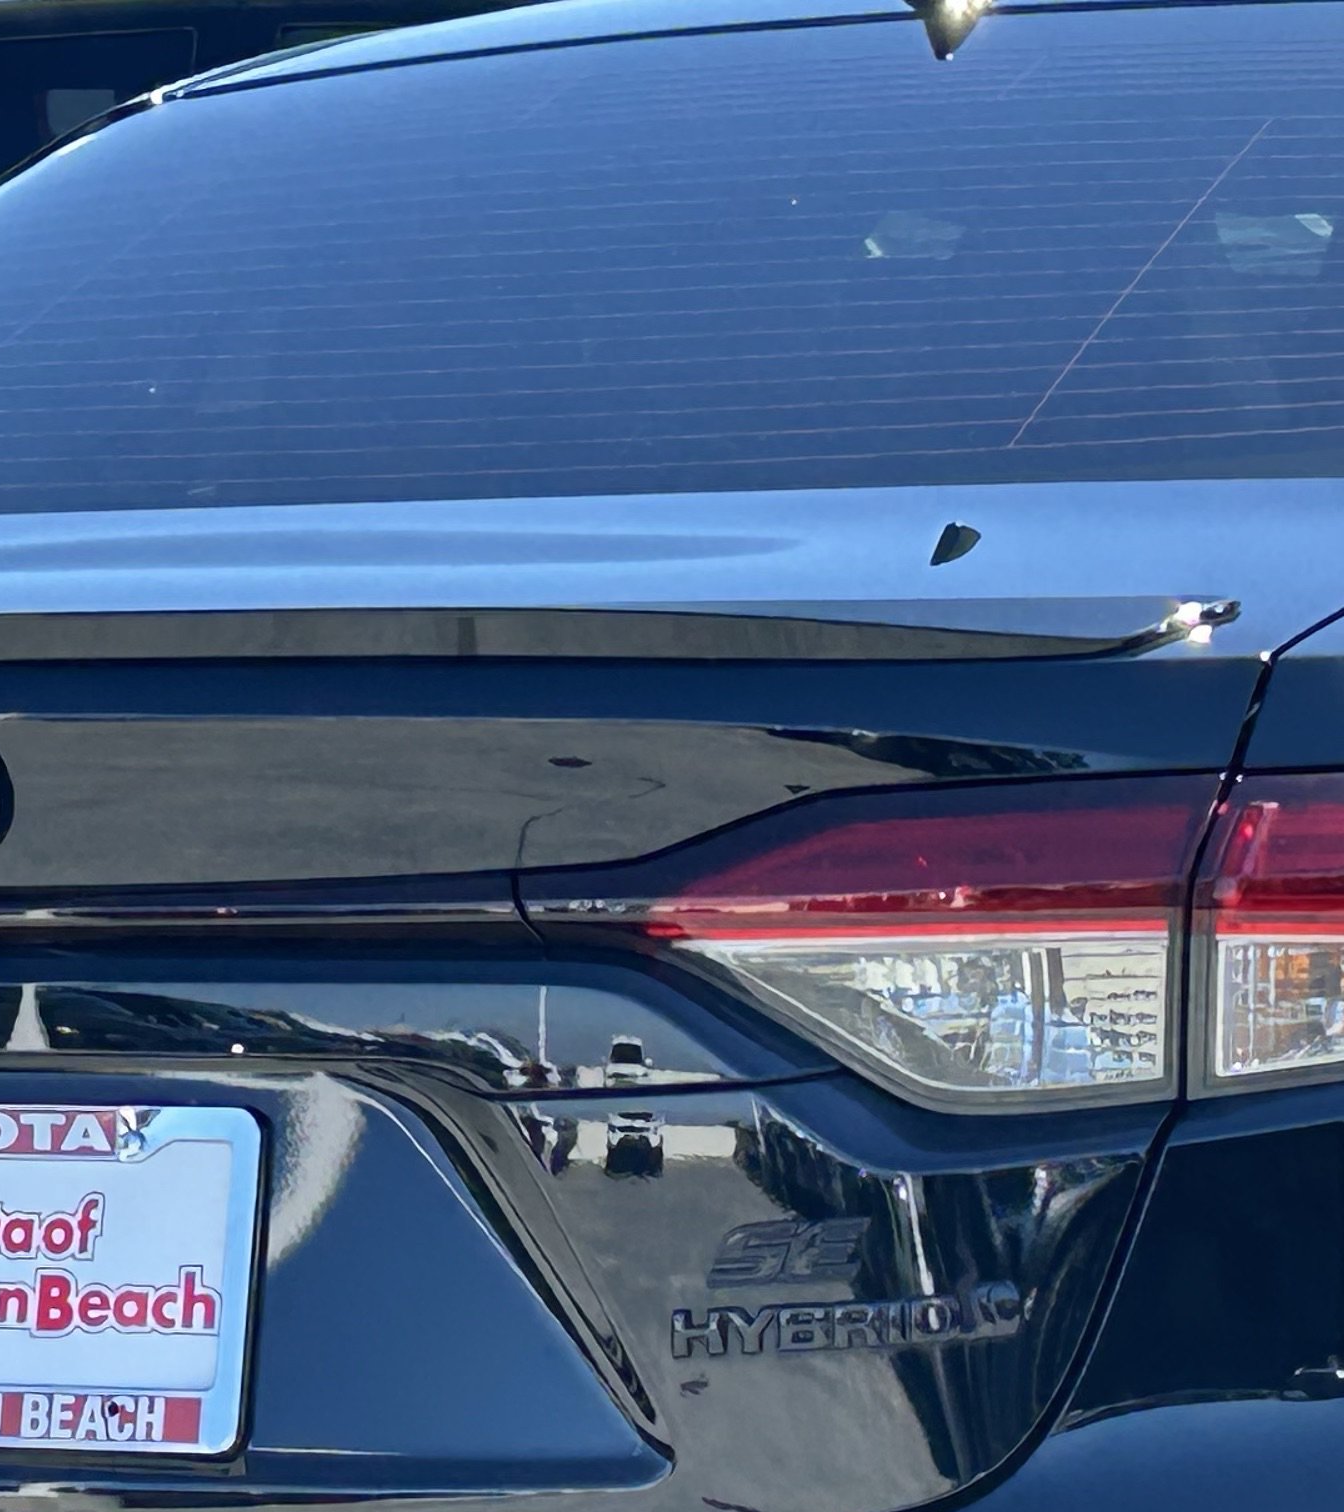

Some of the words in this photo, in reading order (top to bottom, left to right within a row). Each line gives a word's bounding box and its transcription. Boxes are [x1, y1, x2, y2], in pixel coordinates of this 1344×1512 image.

[42, 1199, 99, 1254] of
[707, 1217, 872, 1288] SE
[35, 1273, 216, 1333] Beach
[20, 1394, 165, 1442] BEACH
